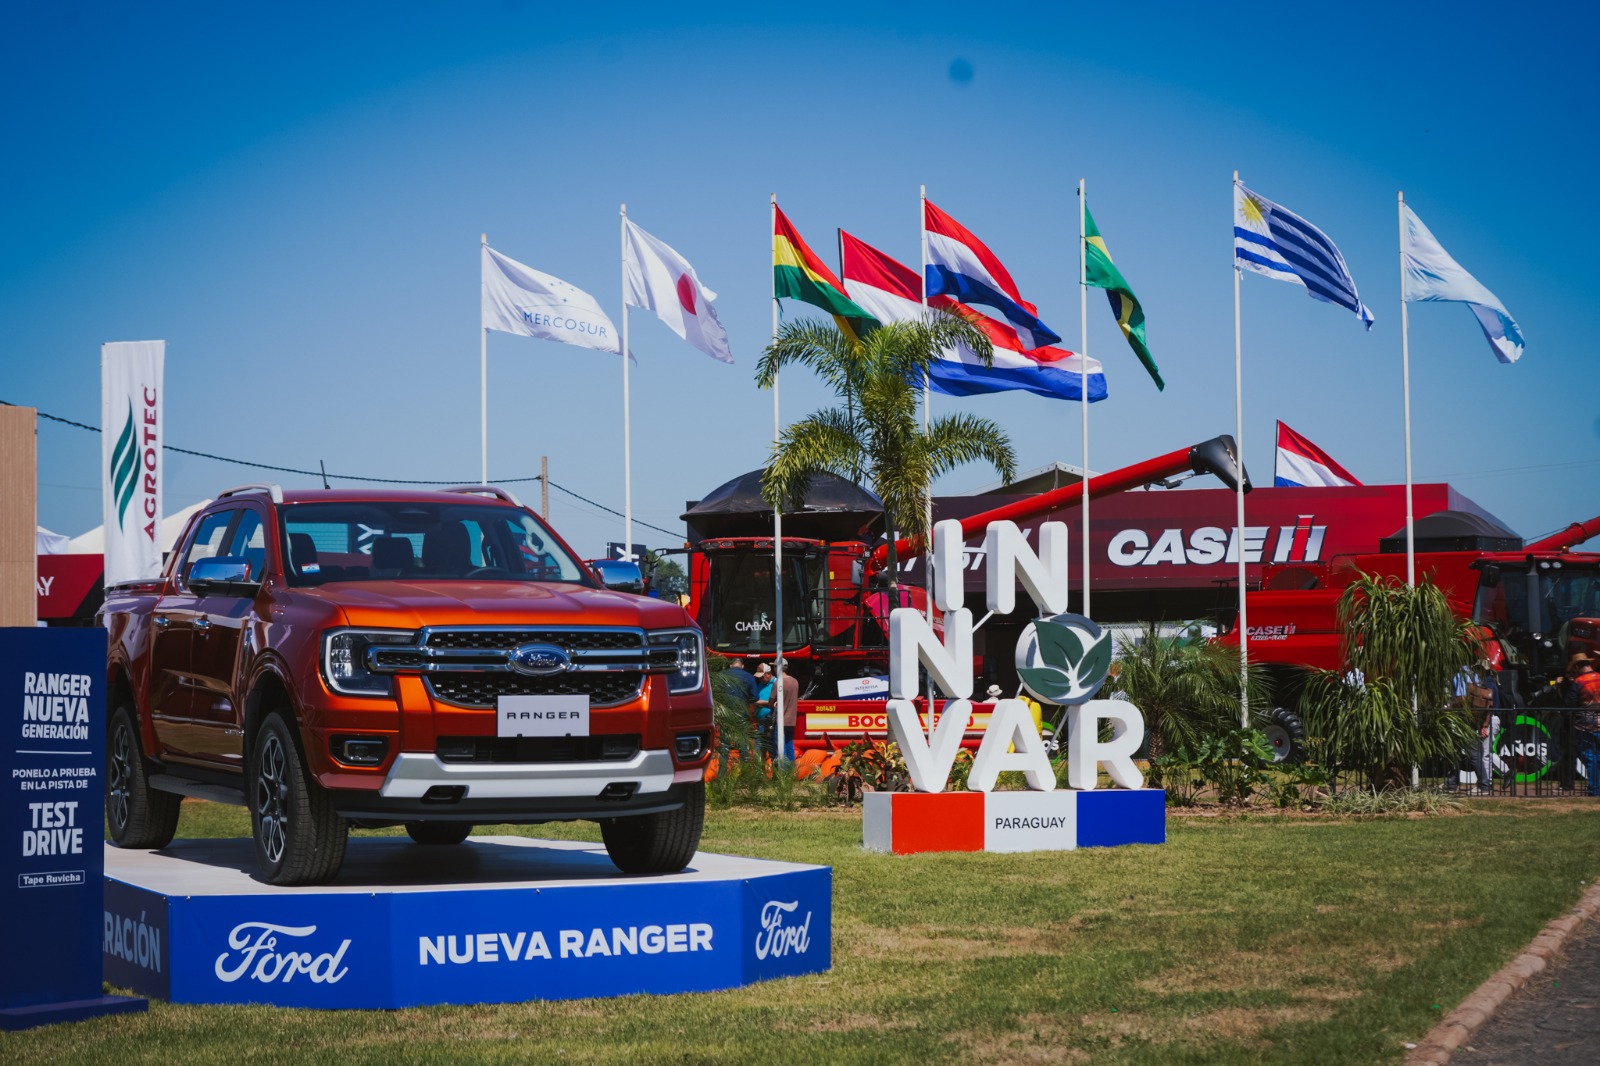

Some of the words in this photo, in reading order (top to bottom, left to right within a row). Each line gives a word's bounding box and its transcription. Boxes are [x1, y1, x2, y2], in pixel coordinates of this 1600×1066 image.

[524, 311, 607, 338] MERCOSUR
[144, 387, 157, 544] AGROTEC
[1107, 526, 1270, 567] CASE
[735, 621, 773, 631] CIABAY
[1246, 625, 1283, 635] CASE
[528, 653, 557, 666] Ford
[24, 672, 91, 696] RANGER
[23, 695, 89, 723] NUEVA
[507, 711, 580, 719] RANGER
[22, 723, 89, 740] GENERACIÓN
[886, 699, 1145, 793] VAR
[12, 769, 50, 778] PONELO
[51, 769, 59, 778] A
[60, 767, 97, 777] PRUEBA
[21, 781, 34, 790] EN
[35, 781, 47, 790] LA
[48, 780, 75, 790] PISTA
[76, 779, 88, 788] DE
[29, 801, 79, 829] TEST
[995, 817, 1066, 830] PARAGUAY
[23, 828, 83, 857] DRIVE
[23, 876, 44, 886] Tape
[46, 873, 81, 884] Ruvicha
[103, 910, 161, 973] RACIÓN
[214, 921, 352, 984] Ford
[418, 930, 553, 966] NUEVA
[559, 922, 714, 959] RANGER
[755, 900, 812, 961] Ford
